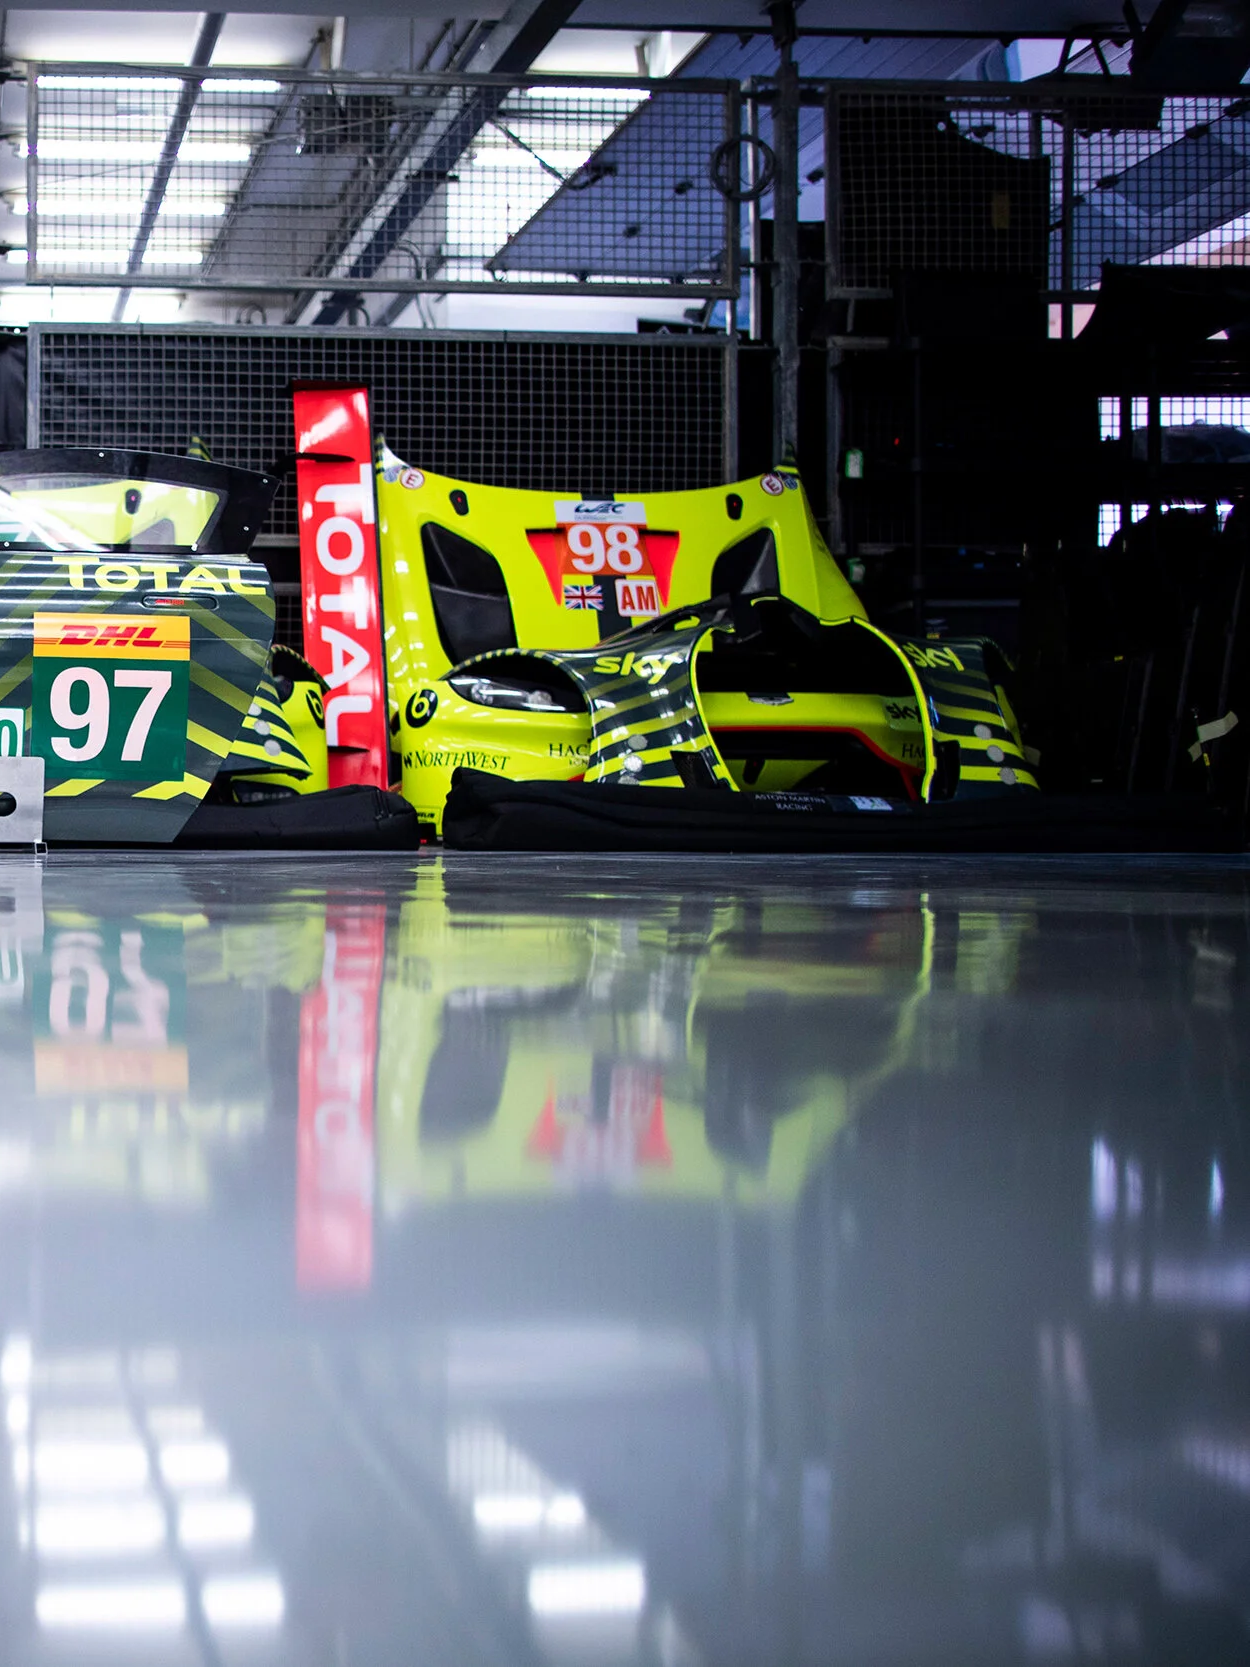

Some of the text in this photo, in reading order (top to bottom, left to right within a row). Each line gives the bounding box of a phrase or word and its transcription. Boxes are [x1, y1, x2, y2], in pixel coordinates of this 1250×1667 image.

[567, 524, 643, 573] 98
[52, 556, 266, 595] TOTAL
[314, 462, 376, 747] TOTAL
[620, 585, 657, 611] AM
[59, 624, 165, 649] DHL
[593, 652, 680, 685] sky
[50, 666, 172, 762] 97
